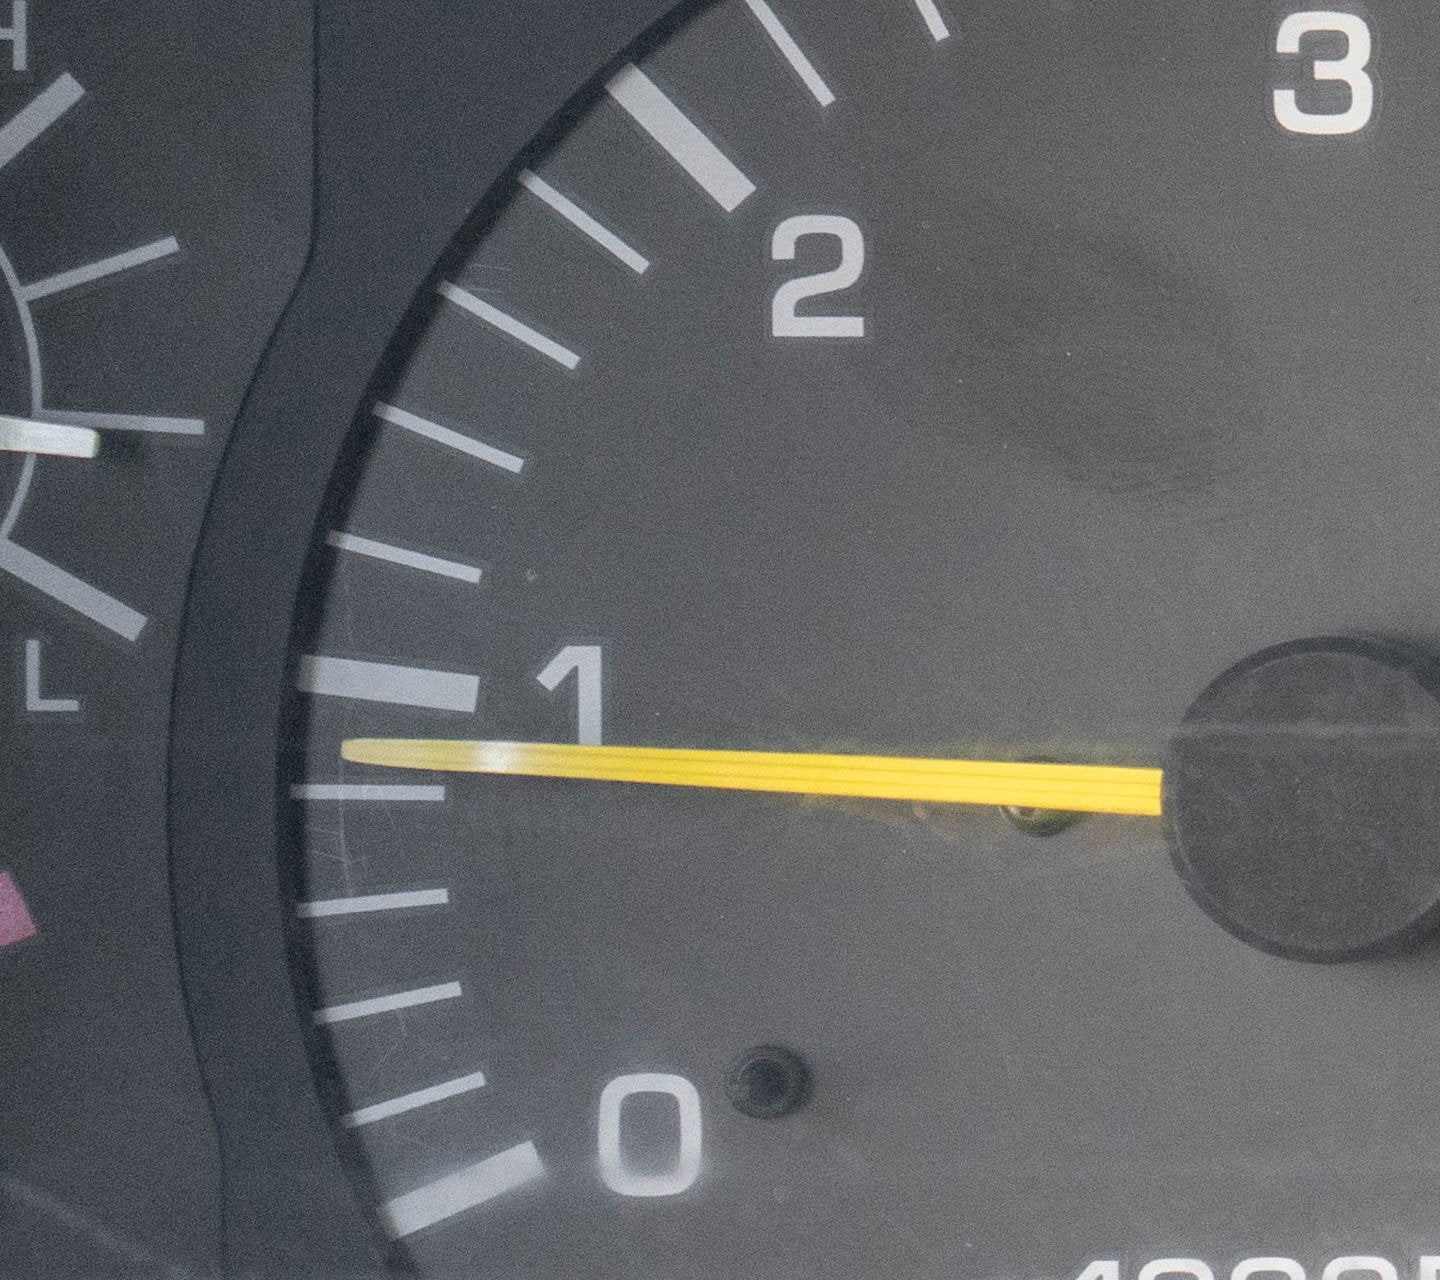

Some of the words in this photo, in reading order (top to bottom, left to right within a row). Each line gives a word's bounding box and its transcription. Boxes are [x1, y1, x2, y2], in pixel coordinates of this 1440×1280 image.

[1272, 11, 1374, 135] 3
[770, 215, 864, 337] 2
[25, 640, 80, 712] L
[537, 646, 602, 745] 1
[597, 1071, 703, 1197] 0
